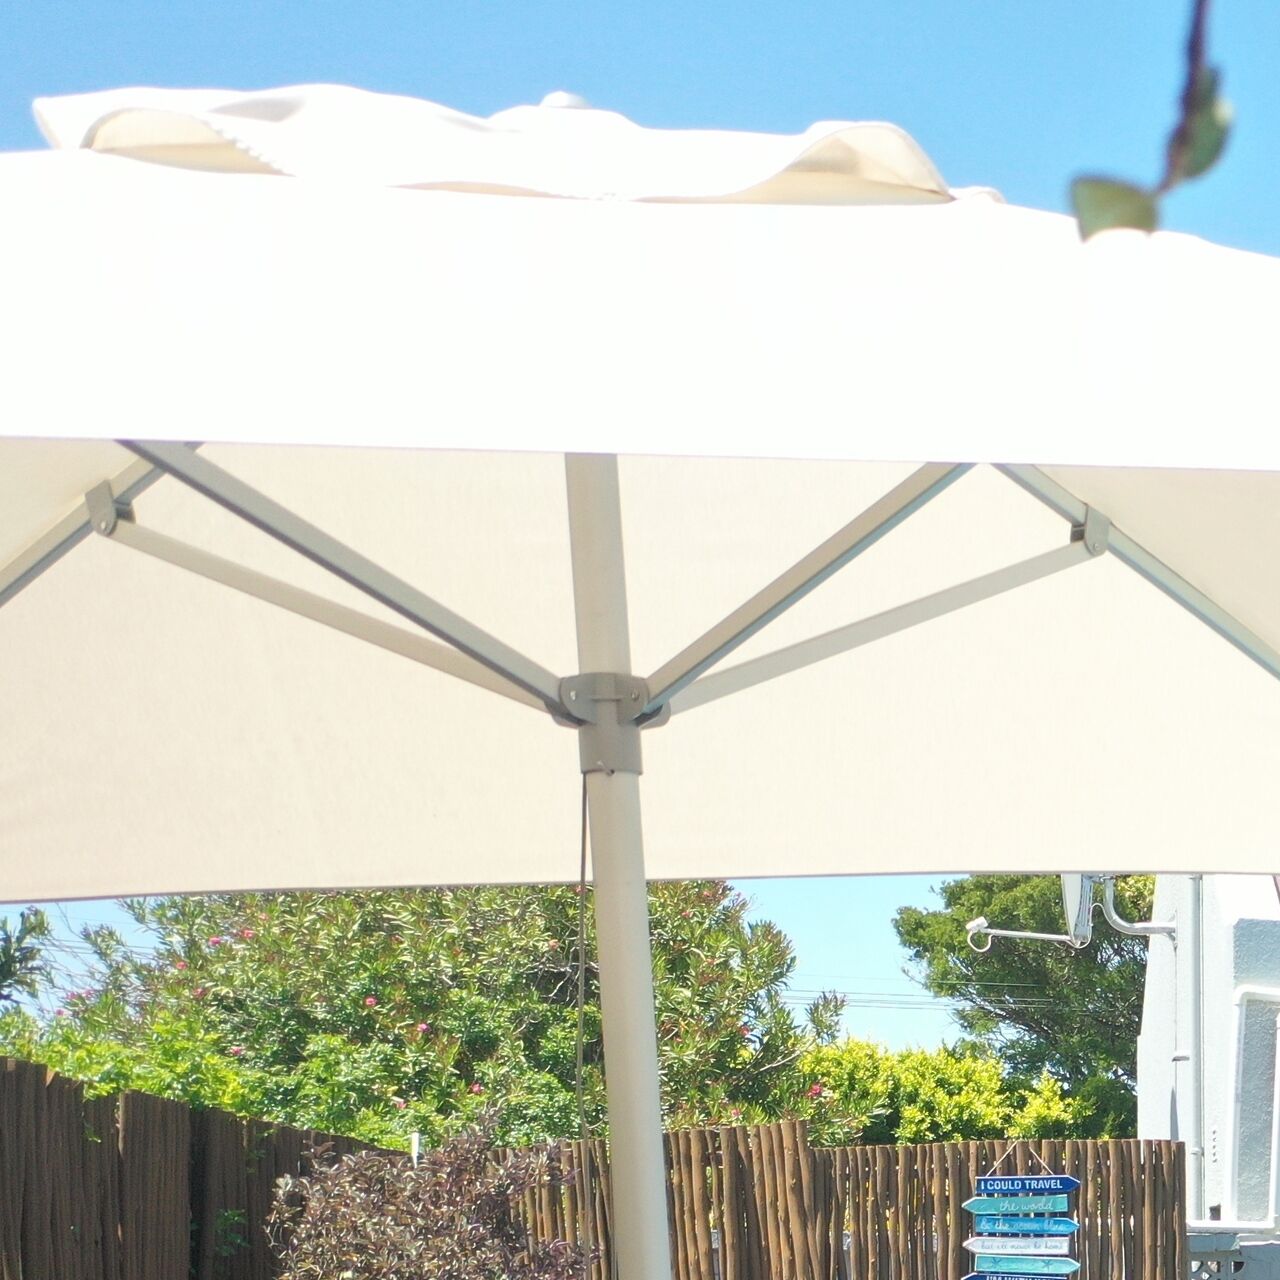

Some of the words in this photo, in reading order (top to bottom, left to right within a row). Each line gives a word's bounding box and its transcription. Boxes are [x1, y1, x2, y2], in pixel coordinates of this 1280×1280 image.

[981, 1181, 985, 1190] I
[987, 1180, 1021, 1190] COULD
[1024, 1179, 1063, 1189] TRAVEL
[1000, 1200, 1020, 1211] the
[1021, 1198, 1053, 1210] world
